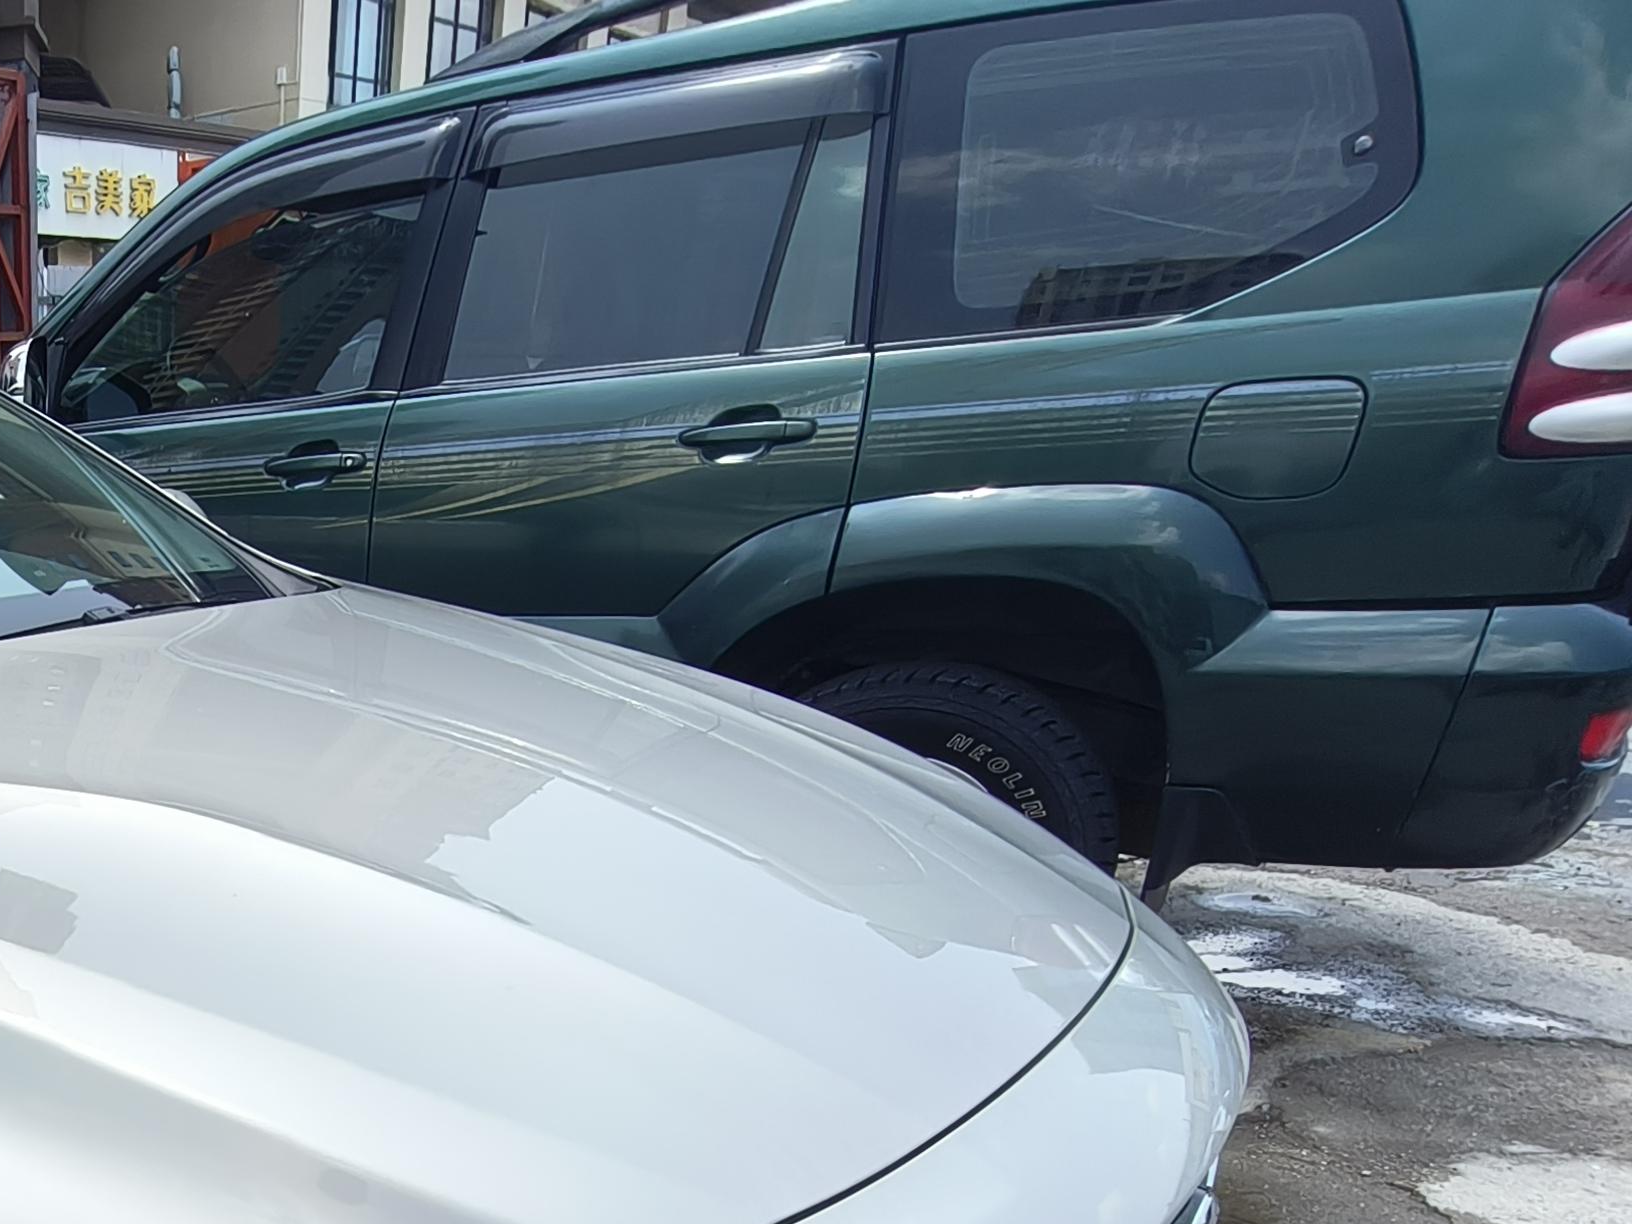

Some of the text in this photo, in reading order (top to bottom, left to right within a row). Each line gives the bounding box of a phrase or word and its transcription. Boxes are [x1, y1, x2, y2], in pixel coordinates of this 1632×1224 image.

[62, 166, 157, 218] 吉美家
[946, 732, 1047, 820] NEOLIN
